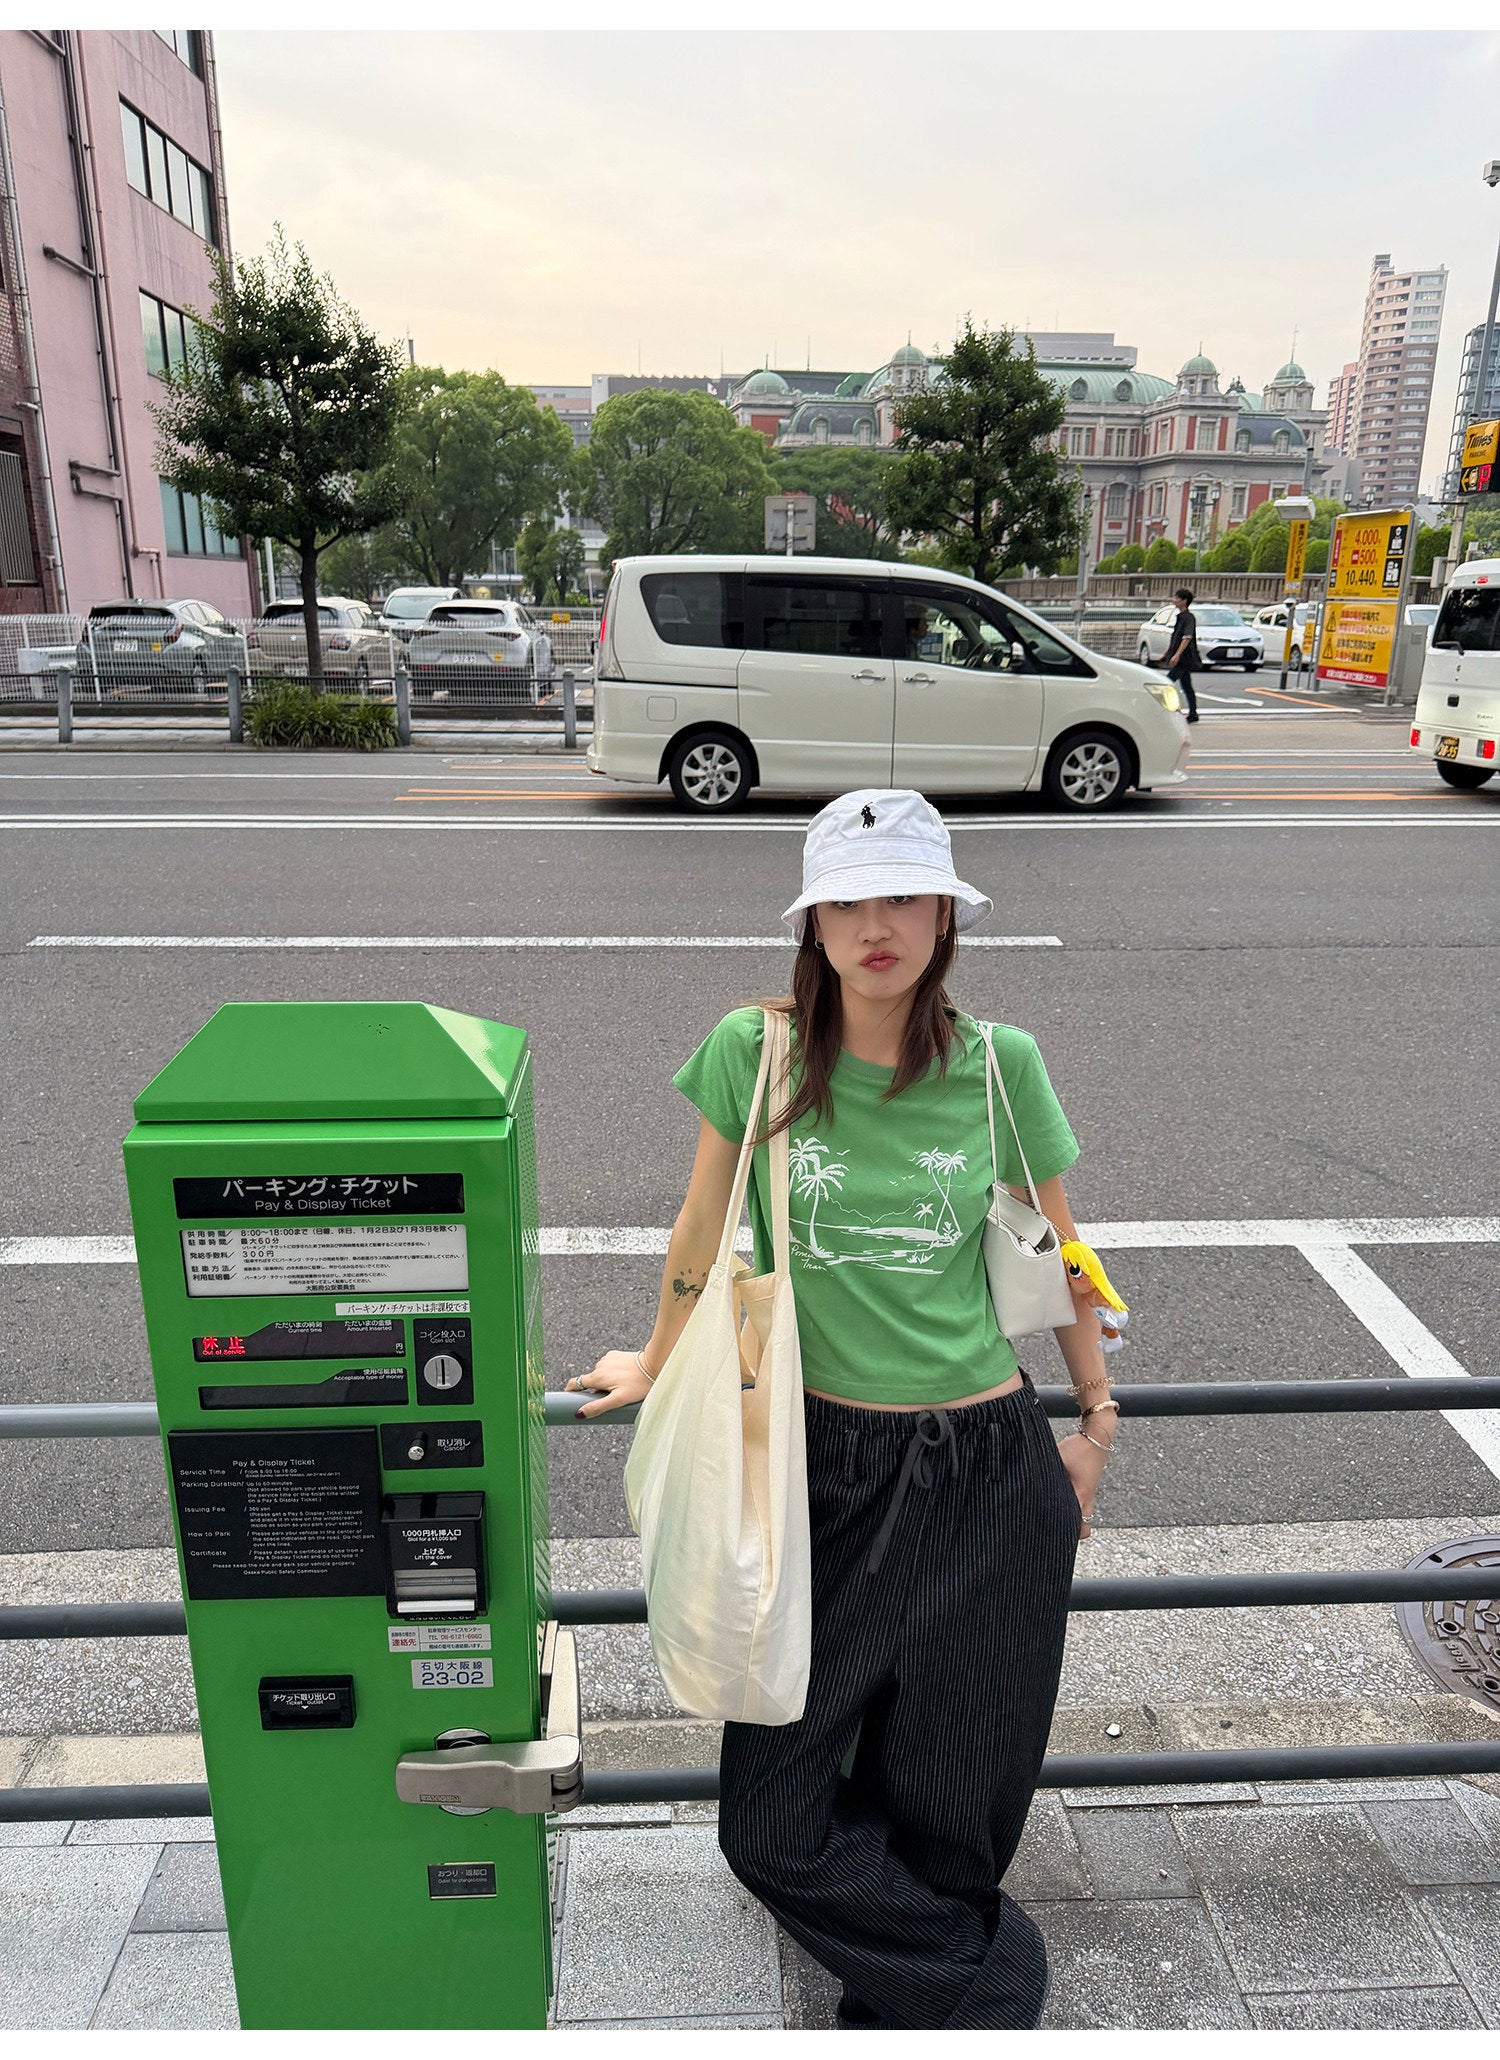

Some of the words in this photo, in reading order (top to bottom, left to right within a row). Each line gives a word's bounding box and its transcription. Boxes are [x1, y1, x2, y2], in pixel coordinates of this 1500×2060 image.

[1467, 432, 1493, 449] Times
[223, 1176, 418, 1197] パーキング・チケット
[255, 1200, 280, 1212] Pay
[284, 1200, 294, 1210] &
[298, 1199, 347, 1211] Display
[350, 1198, 391, 1208] Ticket
[347, 1302, 468, 1314] パーキング・チケットは非課税です
[420, 1330, 466, 1338] コイン投入口
[437, 1438, 471, 1447] 取り消し
[421, 1661, 483, 1671] 石切大阪線
[422, 1671, 484, 1686] 23-02
[273, 1693, 336, 1702] チケット取り出し口
